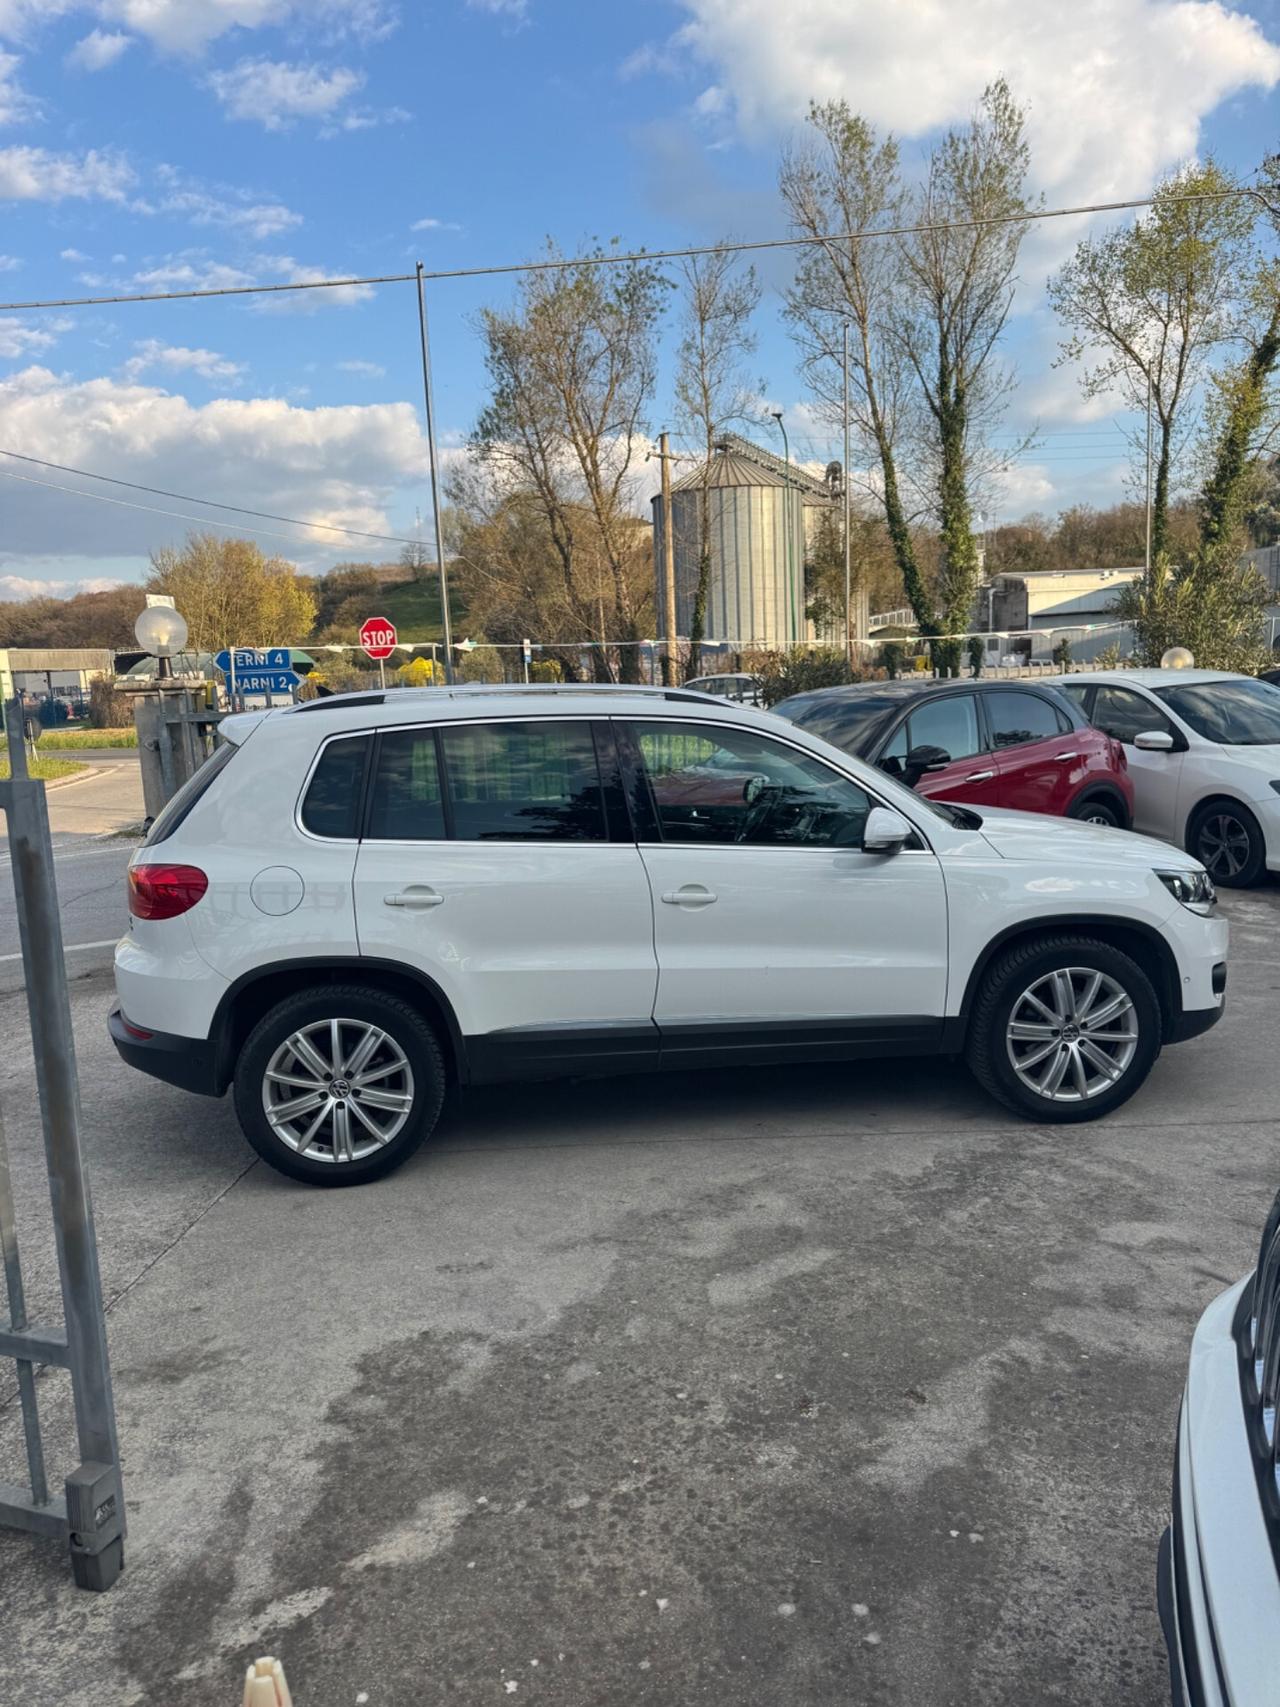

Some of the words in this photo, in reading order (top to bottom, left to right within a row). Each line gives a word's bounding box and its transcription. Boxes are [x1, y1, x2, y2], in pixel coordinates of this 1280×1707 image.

[362, 630, 394, 646] STOP
[228, 653, 269, 667] ERNI
[274, 652, 284, 665] 4
[278, 676, 288, 689] 2
